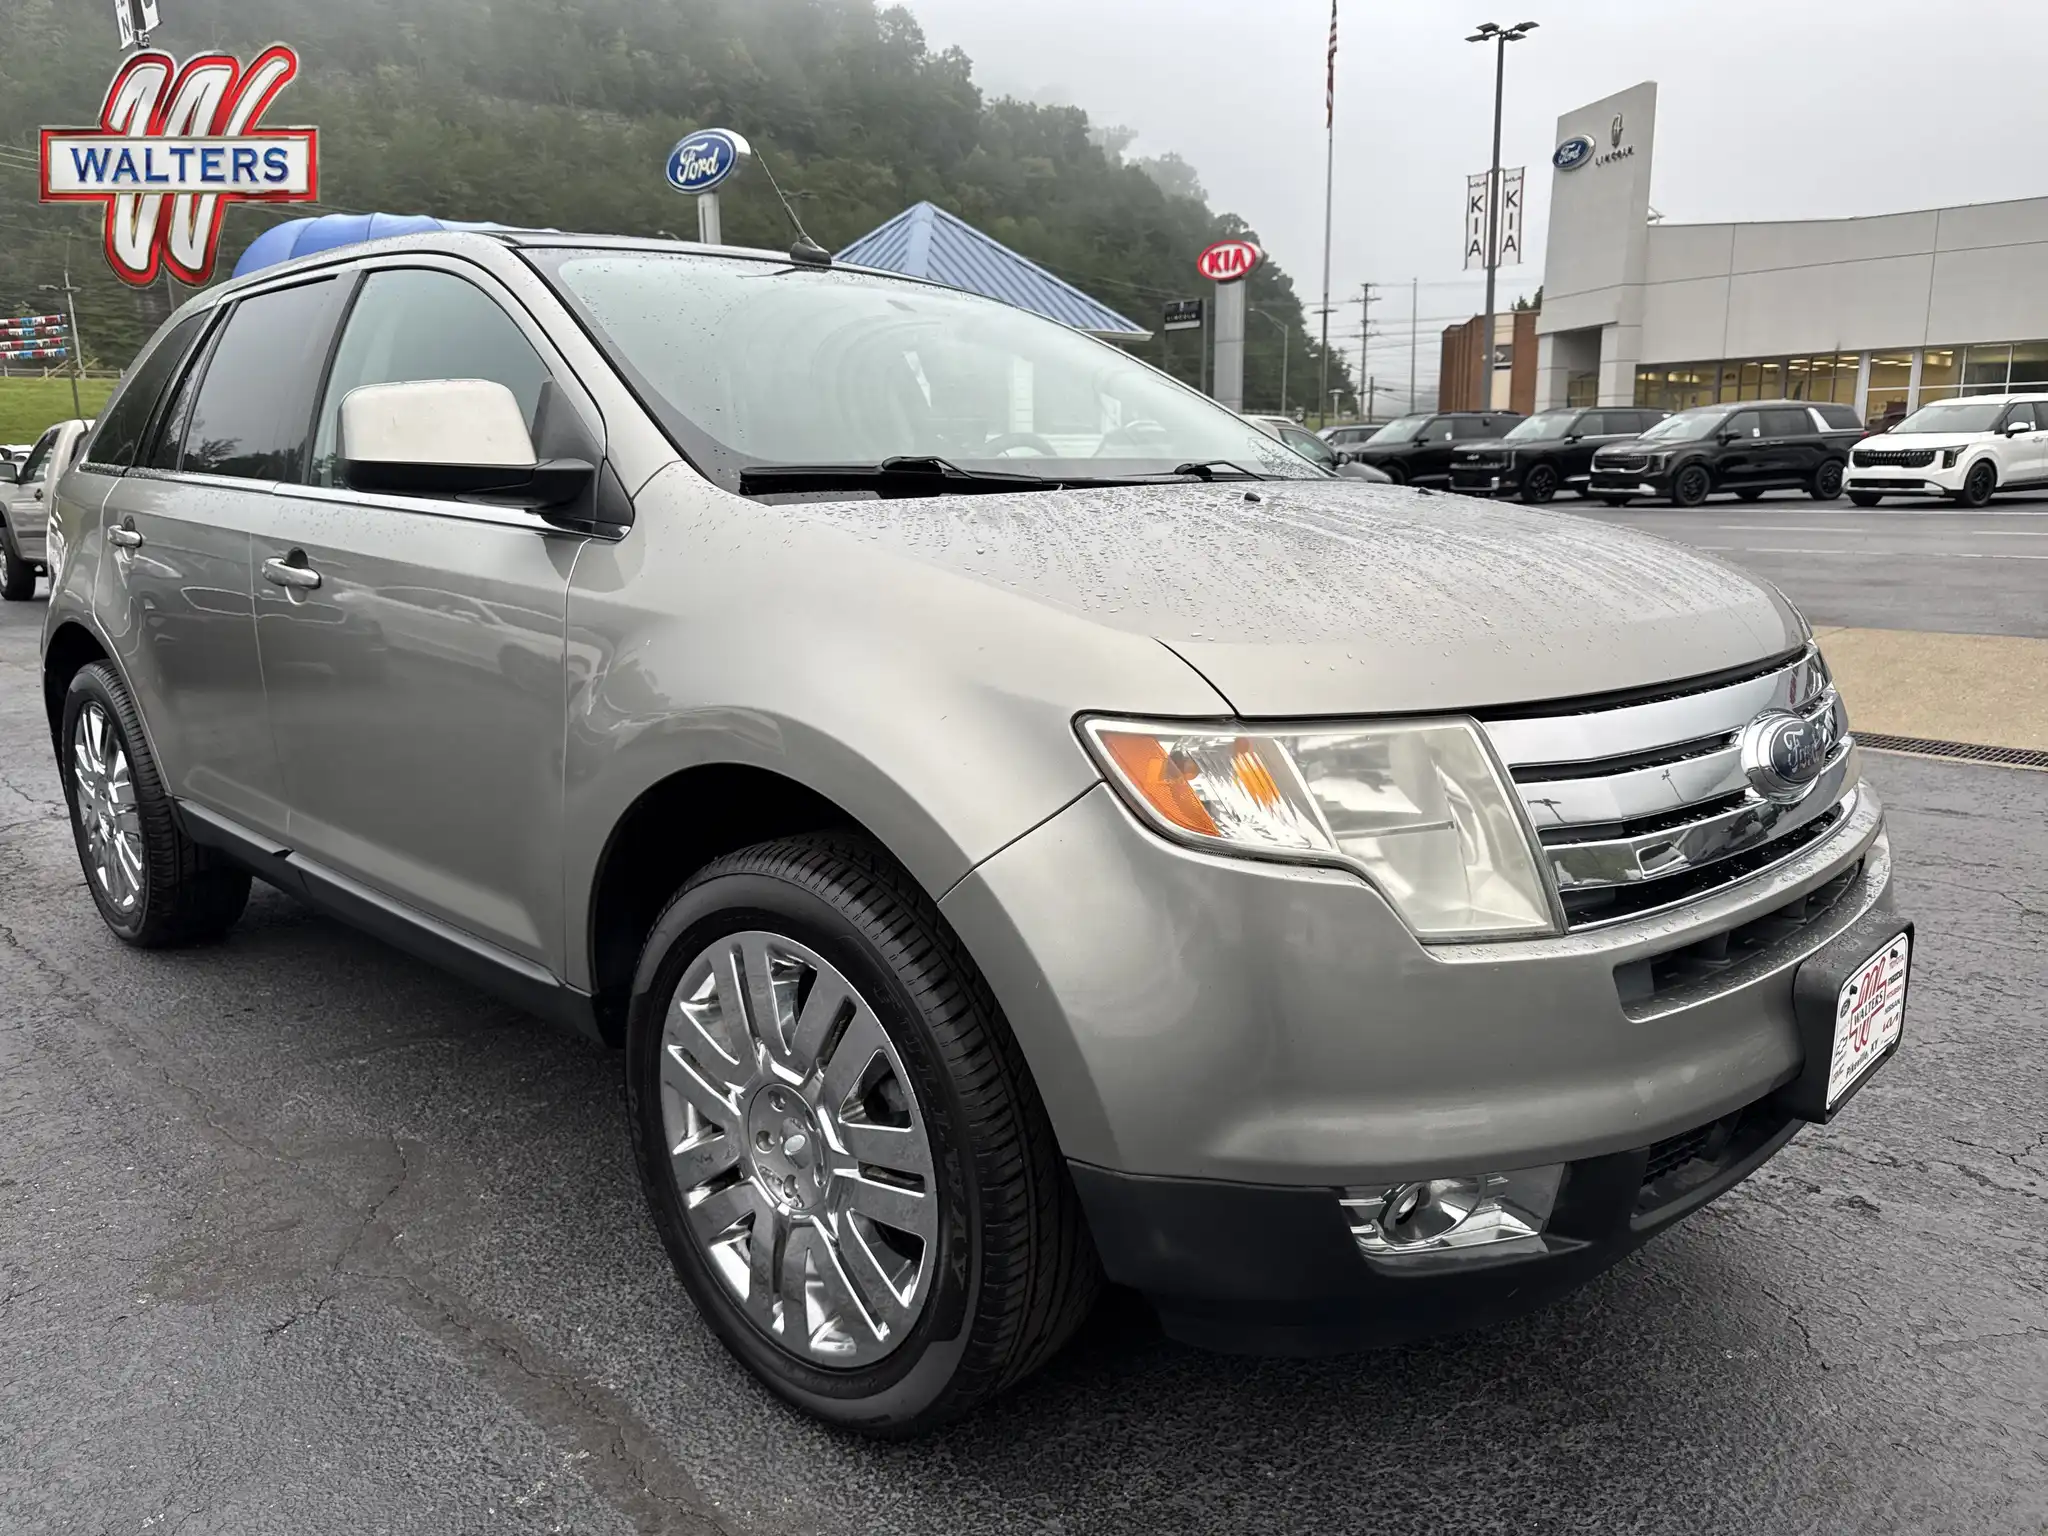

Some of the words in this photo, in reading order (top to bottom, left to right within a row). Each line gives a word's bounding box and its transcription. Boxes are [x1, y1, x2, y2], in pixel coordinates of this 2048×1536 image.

[70, 147, 288, 183] WALTERS
[676, 141, 719, 183] Ford
[1558, 143, 1581, 164] Ford
[1468, 195, 1485, 257] KIA
[1503, 189, 1519, 253] KIA
[1208, 248, 1246, 274] KIA
[1783, 728, 1821, 773] Ford
[1853, 991, 1883, 1026] WALTERS
